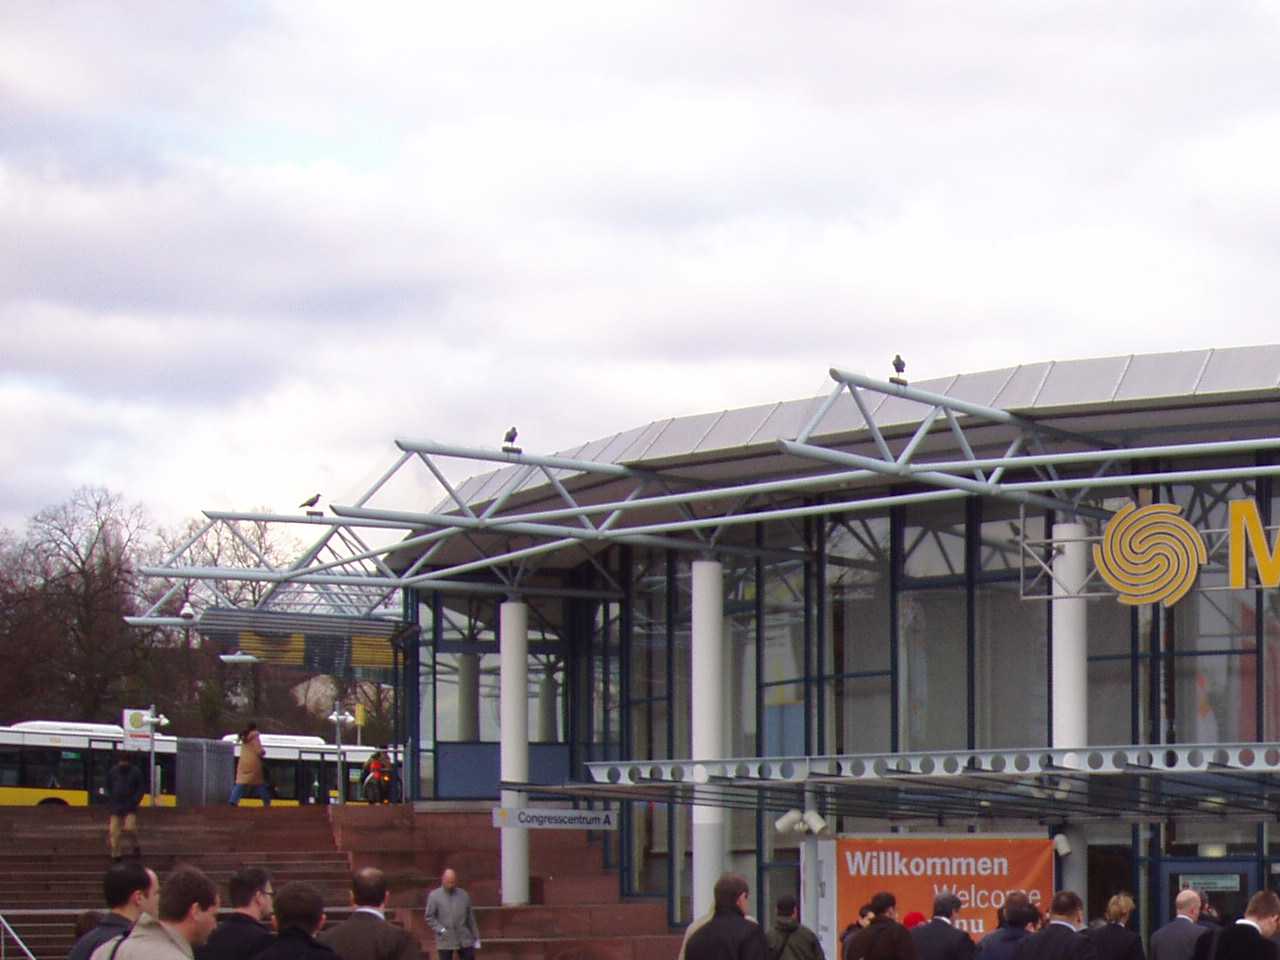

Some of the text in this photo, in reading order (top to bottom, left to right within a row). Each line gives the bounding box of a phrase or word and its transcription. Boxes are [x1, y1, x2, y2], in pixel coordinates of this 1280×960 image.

[518, 811, 611, 826] Congresscentrum A
[845, 850, 1009, 877] Willkommen
[933, 883, 1042, 909] Welcoe
